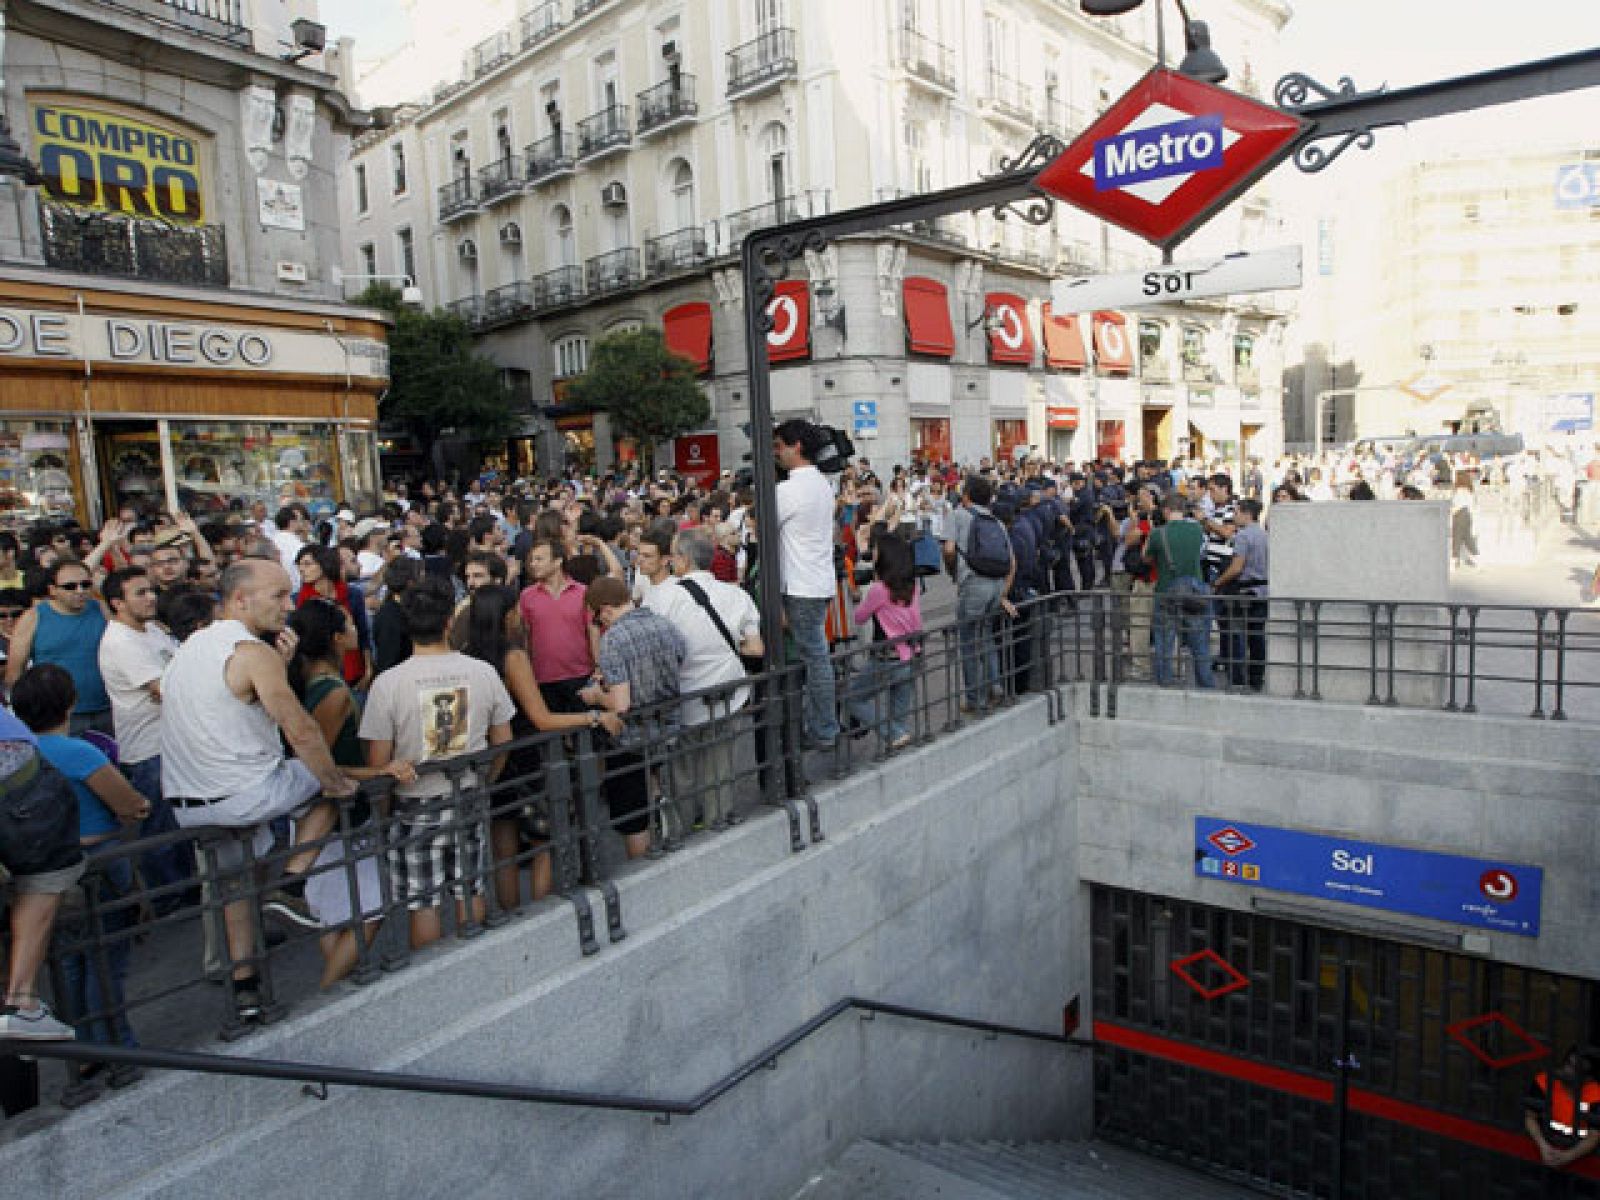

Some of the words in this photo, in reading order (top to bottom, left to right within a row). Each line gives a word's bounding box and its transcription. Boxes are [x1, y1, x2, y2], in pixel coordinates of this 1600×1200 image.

[36, 107, 194, 165] COMPRO
[1104, 131, 1215, 178] Metro
[41, 144, 201, 221] ORO
[1142, 271, 1193, 296] Sol
[107, 319, 273, 366] DIEGO
[1331, 849, 1374, 876] Sol
